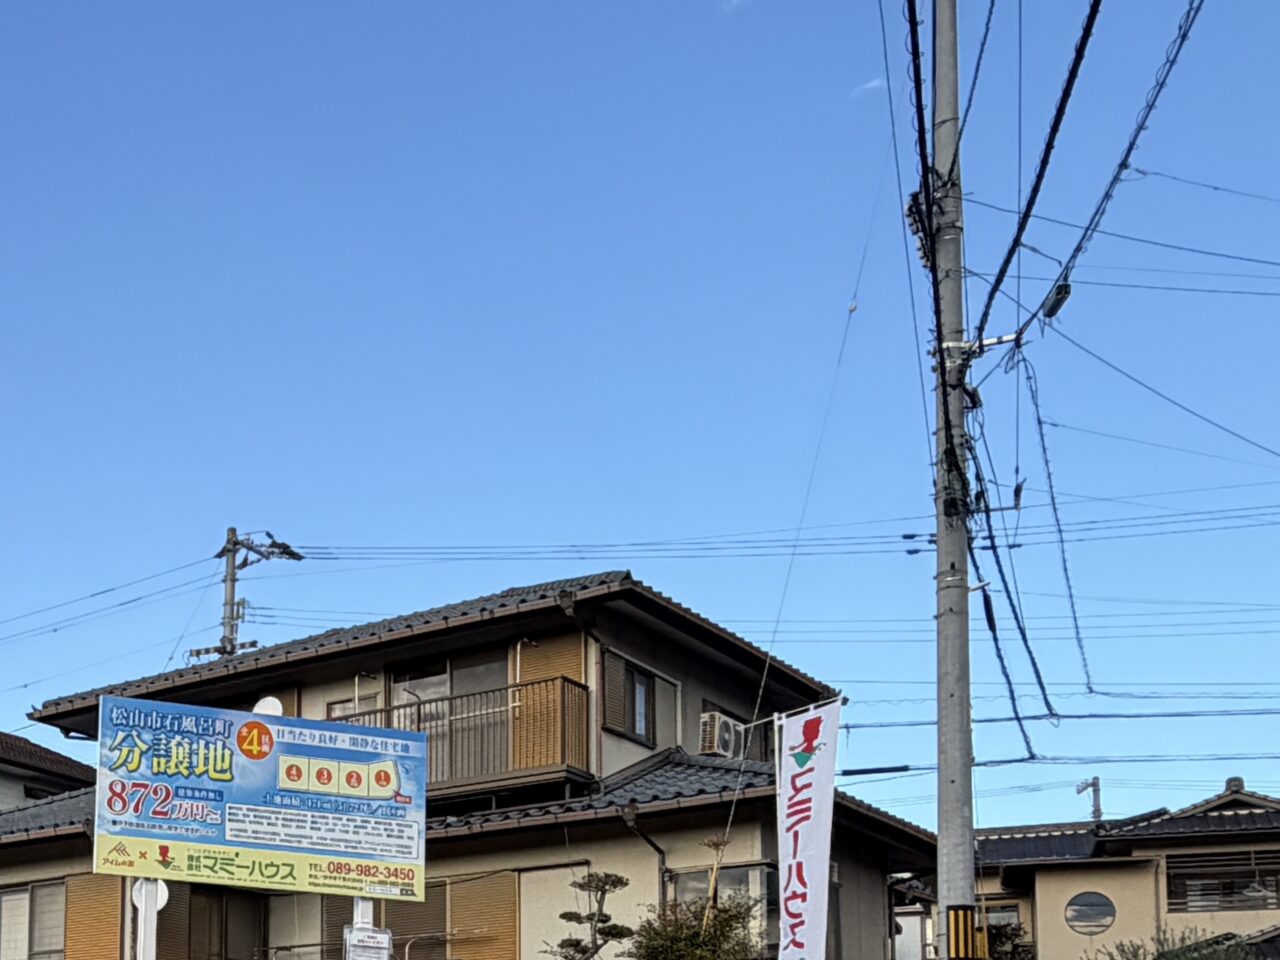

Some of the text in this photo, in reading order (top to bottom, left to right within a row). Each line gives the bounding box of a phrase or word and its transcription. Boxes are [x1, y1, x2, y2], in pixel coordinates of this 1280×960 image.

[111, 706, 233, 739] 松山市石風呂町
[109, 730, 234, 782] 分譲地
[202, 854, 297, 882] マミーハウス
[327, 861, 415, 882] 089-982-3450
